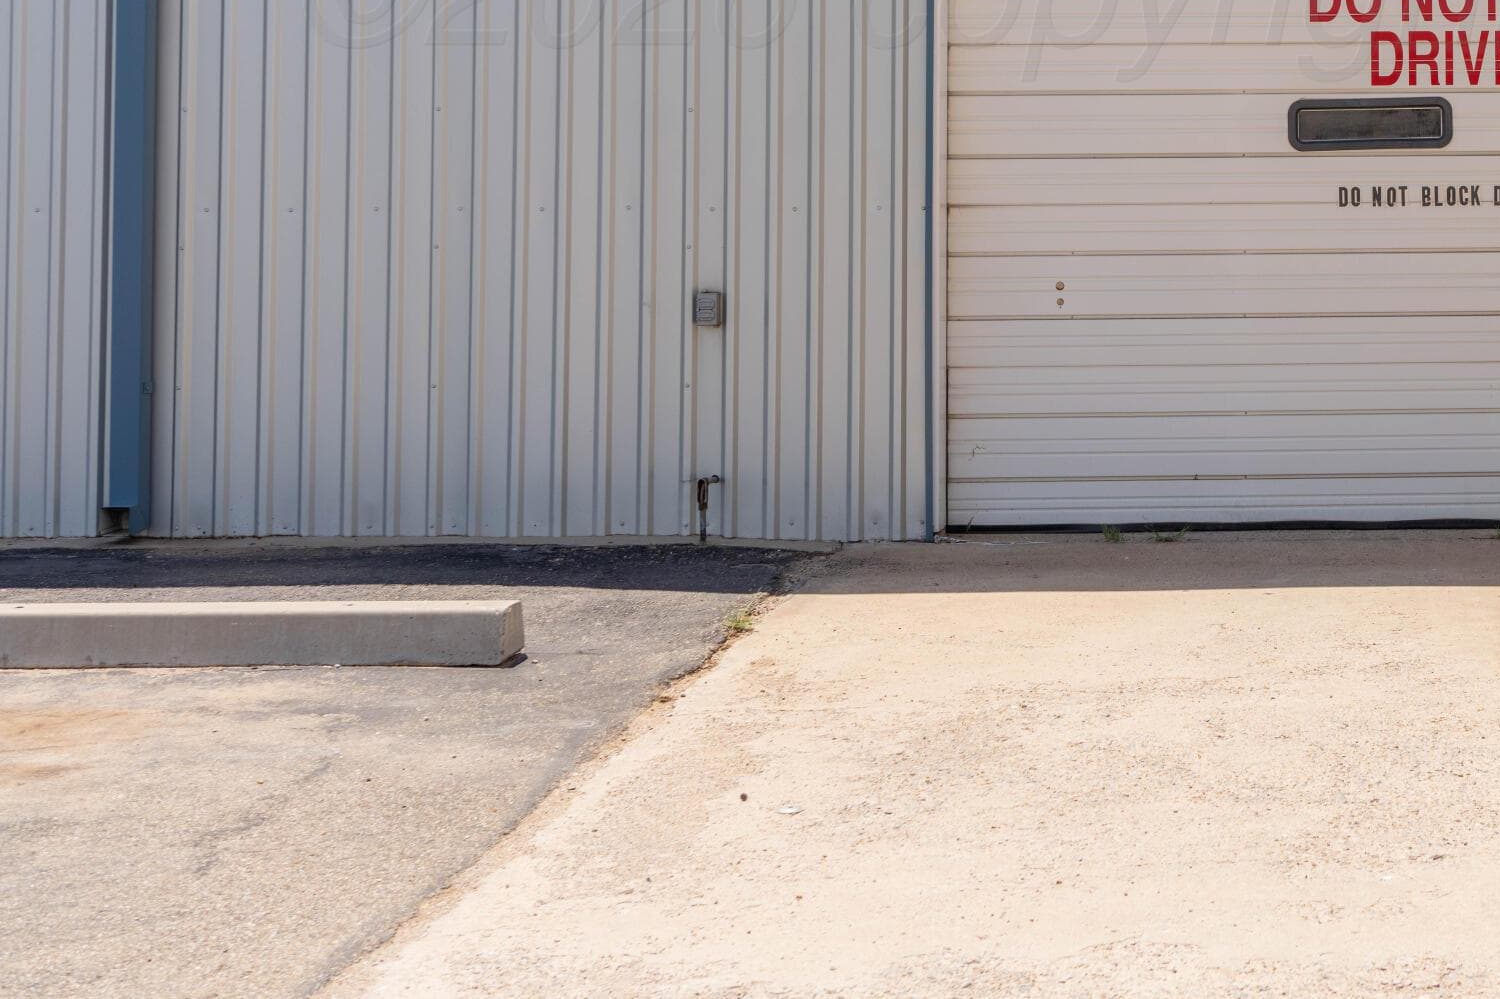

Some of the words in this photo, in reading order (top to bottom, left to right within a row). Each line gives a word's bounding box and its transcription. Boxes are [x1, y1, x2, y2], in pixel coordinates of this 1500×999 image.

[1338, 186, 1361, 208] DO
[1372, 185, 1408, 207] NOT
[1421, 185, 1481, 207] BLOCK
